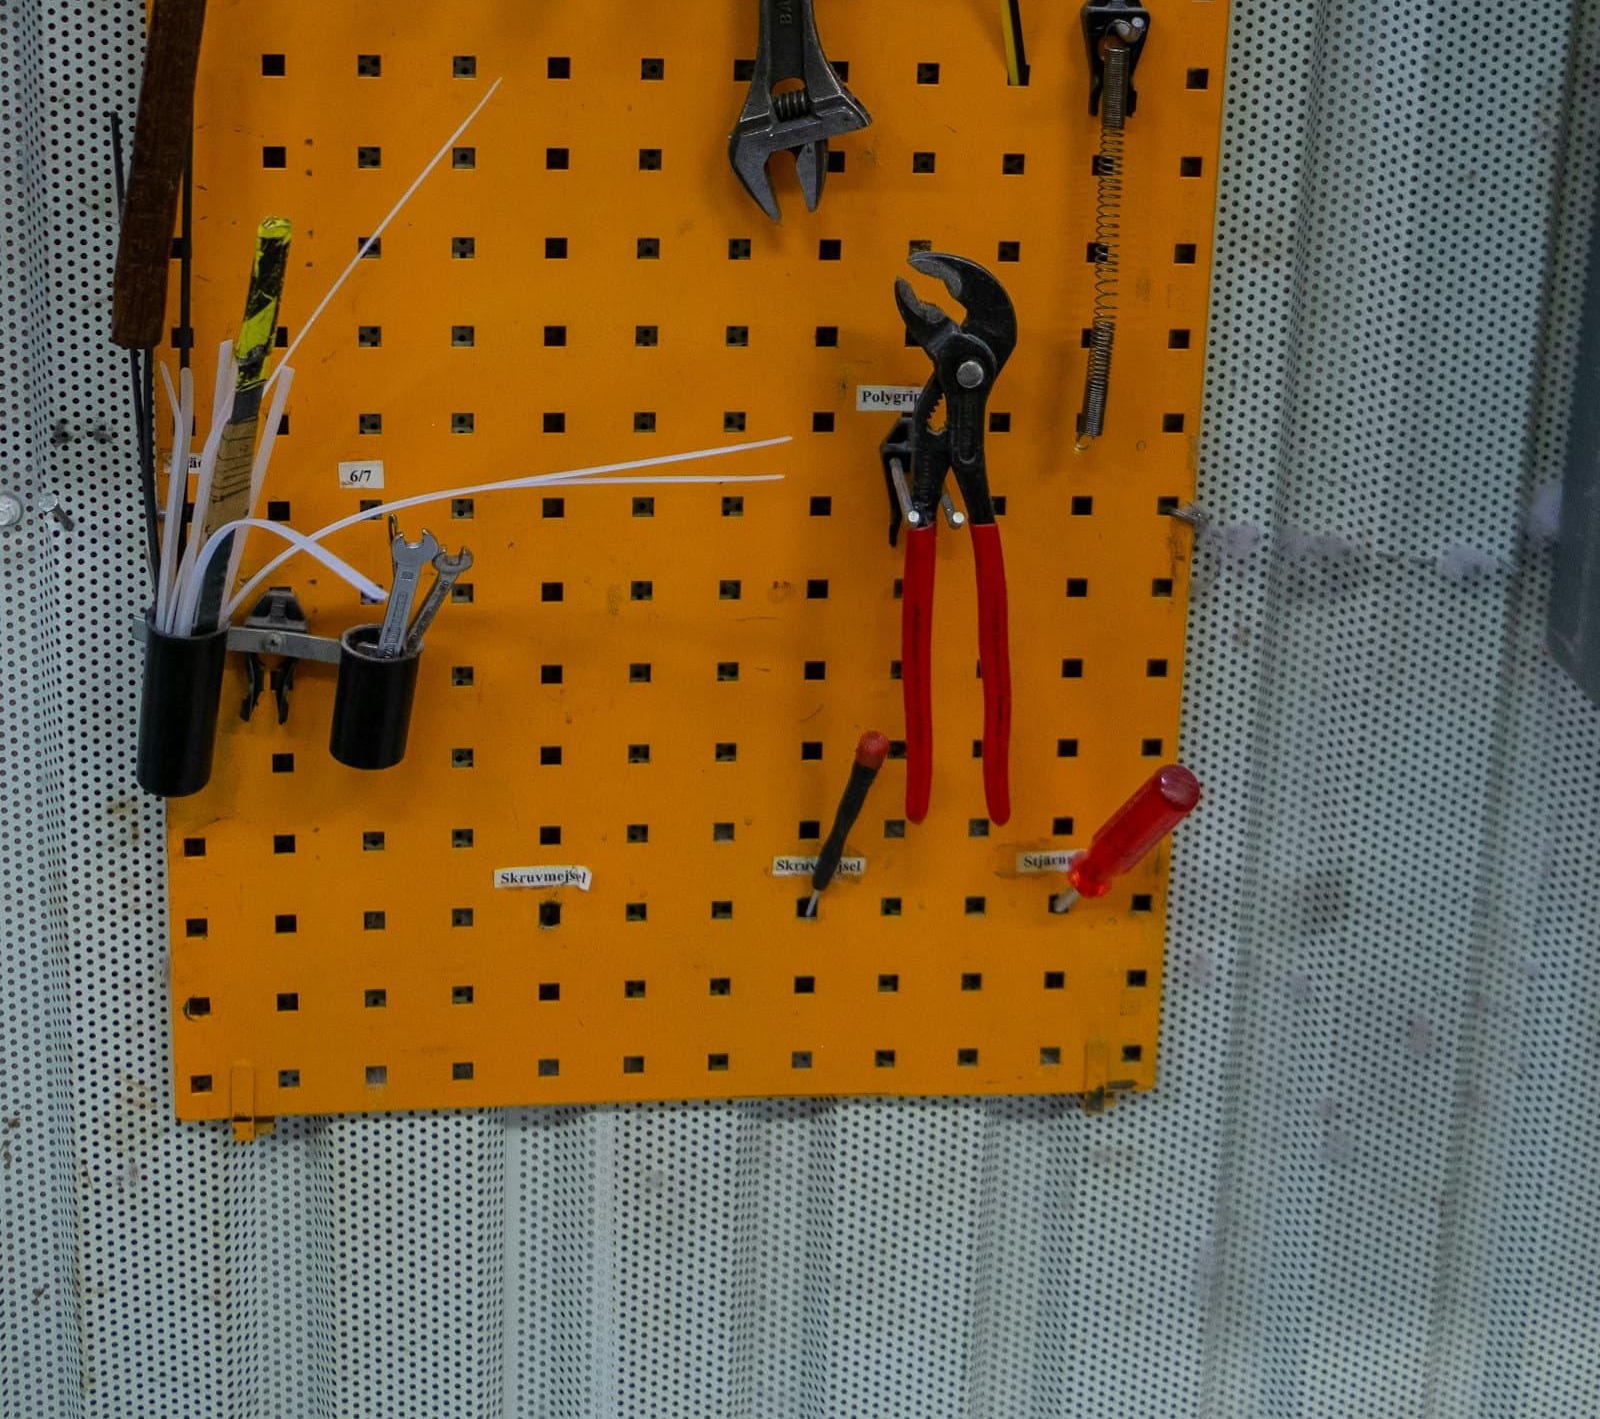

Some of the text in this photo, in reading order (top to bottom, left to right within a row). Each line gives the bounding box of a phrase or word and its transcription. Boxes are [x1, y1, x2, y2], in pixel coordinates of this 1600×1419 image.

[350, 469, 372, 483] 6/7
[775, 859, 861, 873] Skruvjsel
[1023, 854, 1073, 869] Stjärn
[500, 868, 587, 885] Skruvmejsel
